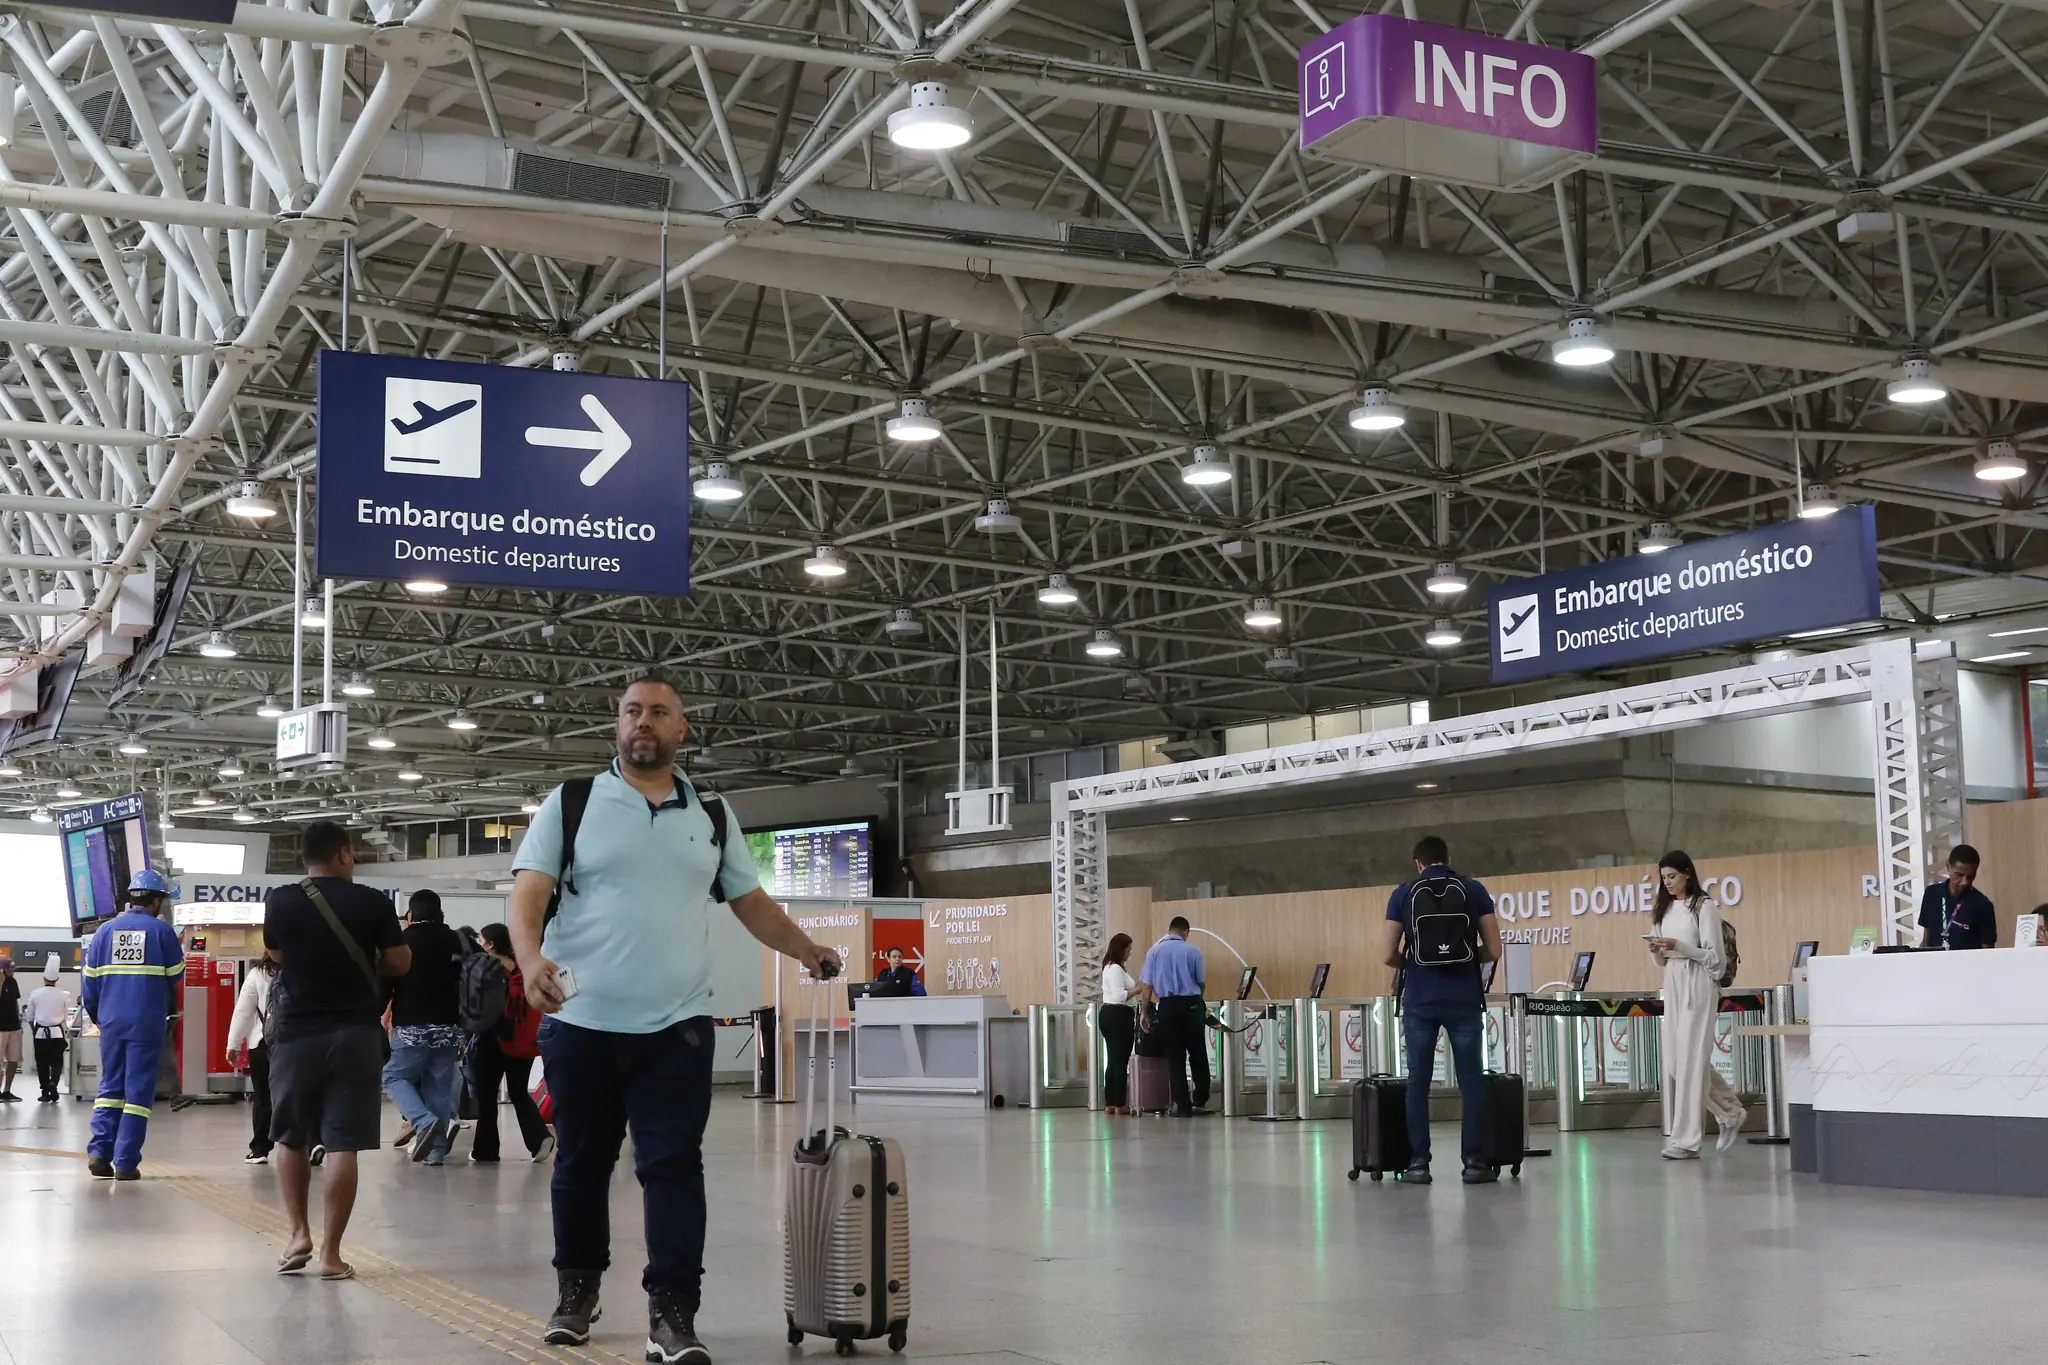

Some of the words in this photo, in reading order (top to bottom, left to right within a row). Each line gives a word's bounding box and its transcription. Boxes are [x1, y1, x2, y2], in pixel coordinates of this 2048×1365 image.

[1414, 40, 1567, 128] INFO
[357, 498, 504, 535] Embarque
[512, 509, 656, 542] doméstico
[394, 539, 499, 565] Domestic
[504, 547, 621, 572] departures
[1555, 571, 1671, 615] Embarque
[1678, 543, 1813, 590] doméstico
[1556, 617, 1640, 652] Domestic
[1643, 601, 1744, 639] departures
[1490, 890, 1551, 923] QUE
[1570, 874, 1742, 917] DOMÉCO
[945, 903, 1007, 920] PRIORIDADES
[799, 913, 859, 929] FUNCIONÁRIOS
[945, 922, 964, 934] POR
[966, 920, 980, 933] LEI
[119, 934, 141, 946] 909
[945, 936, 973, 945] PRIORITIES
[973, 936, 980, 944] BY
[980, 935, 992, 943] LAW
[113, 948, 142, 960] 4223
[1528, 1001, 1571, 1013] RIOgaleão
